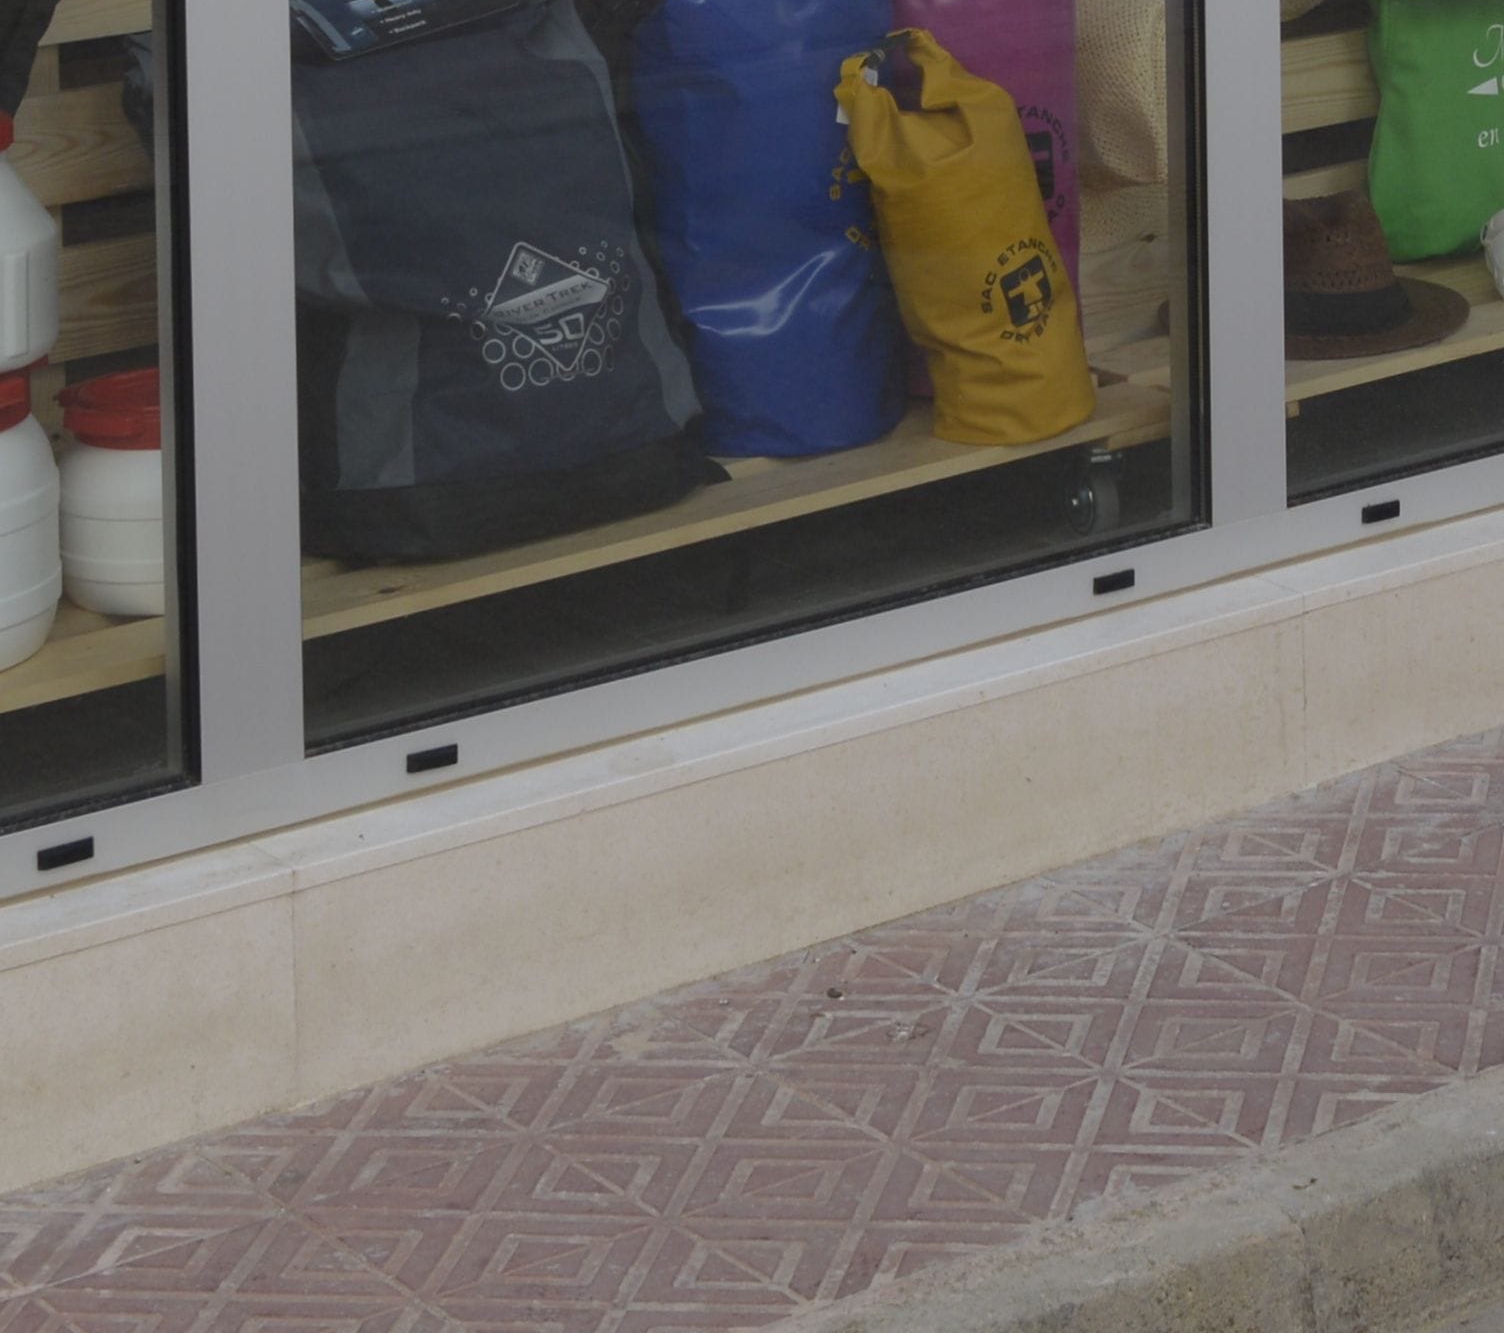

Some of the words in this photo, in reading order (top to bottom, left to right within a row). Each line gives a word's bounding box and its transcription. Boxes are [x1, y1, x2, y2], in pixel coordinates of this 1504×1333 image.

[1478, 128, 1499, 148] en
[546, 280, 593, 302] TREK
[981, 272, 997, 313] SAC
[534, 312, 585, 346] 50
